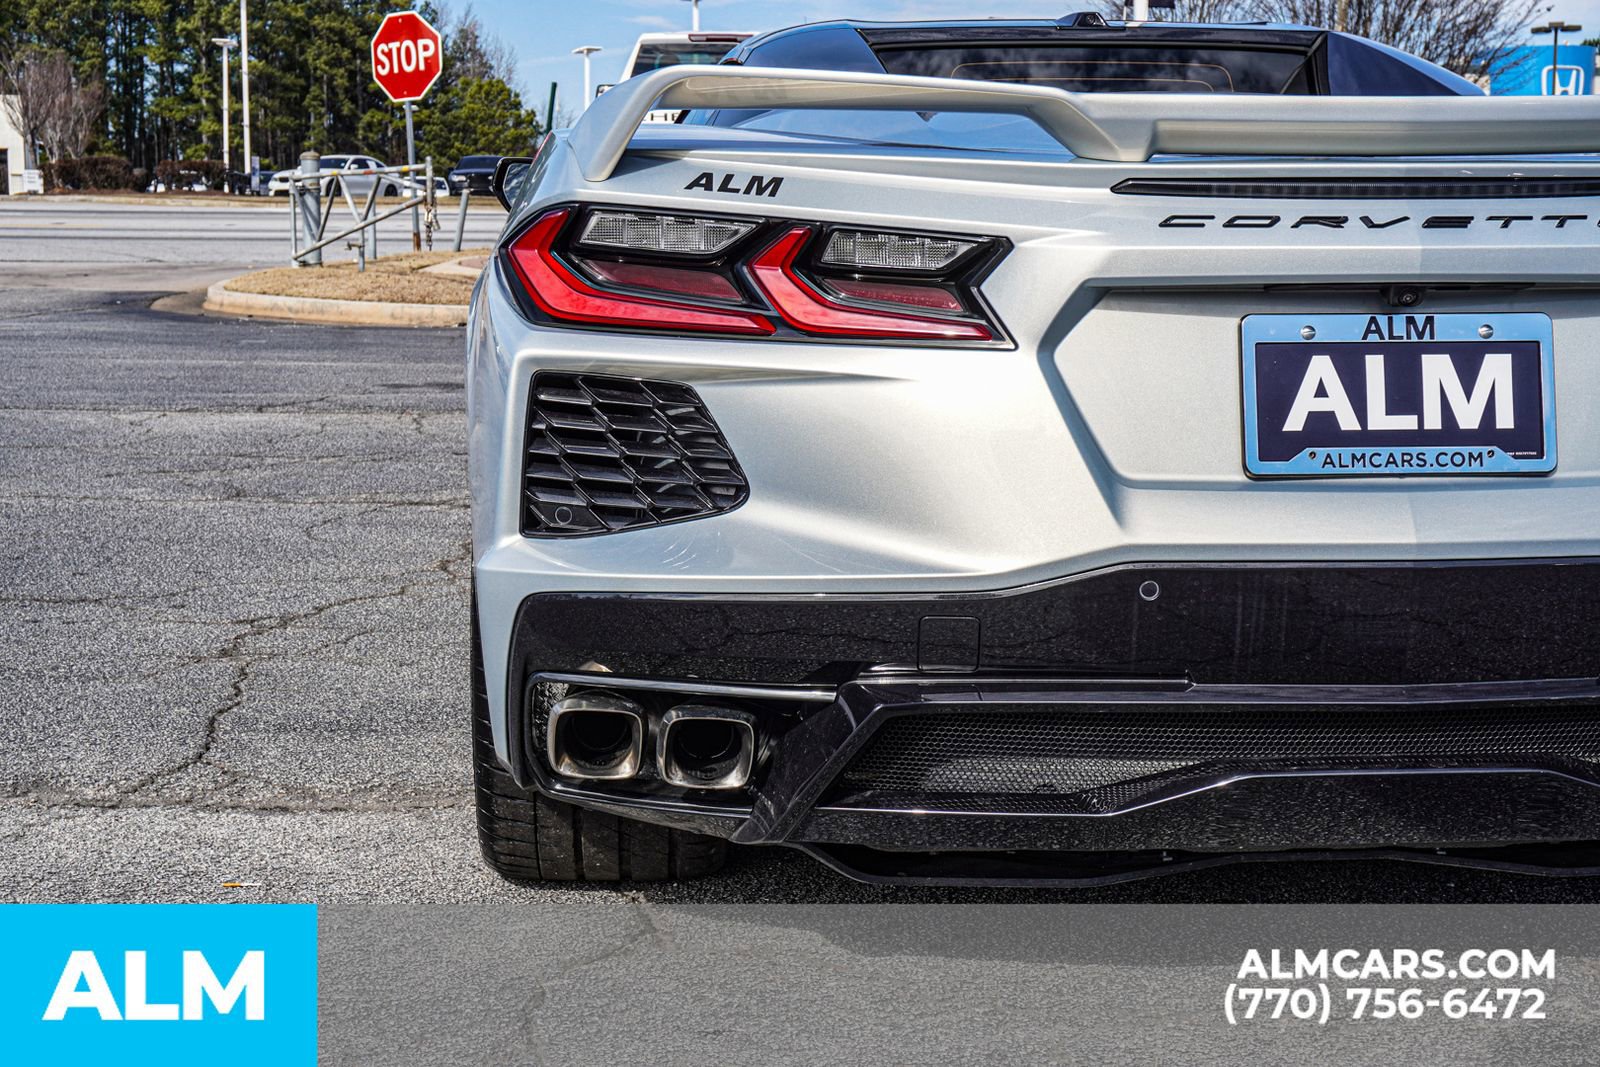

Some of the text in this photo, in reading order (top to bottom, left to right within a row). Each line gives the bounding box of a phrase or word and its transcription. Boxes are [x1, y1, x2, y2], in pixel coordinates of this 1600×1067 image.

[376, 39, 435, 76] STOP
[684, 172, 785, 198] ALM
[1158, 214, 1600, 229] CORVETT
[1361, 315, 1435, 341] ALM
[1282, 353, 1515, 432] ALM
[1321, 451, 1484, 469] ALMCARS.COM
